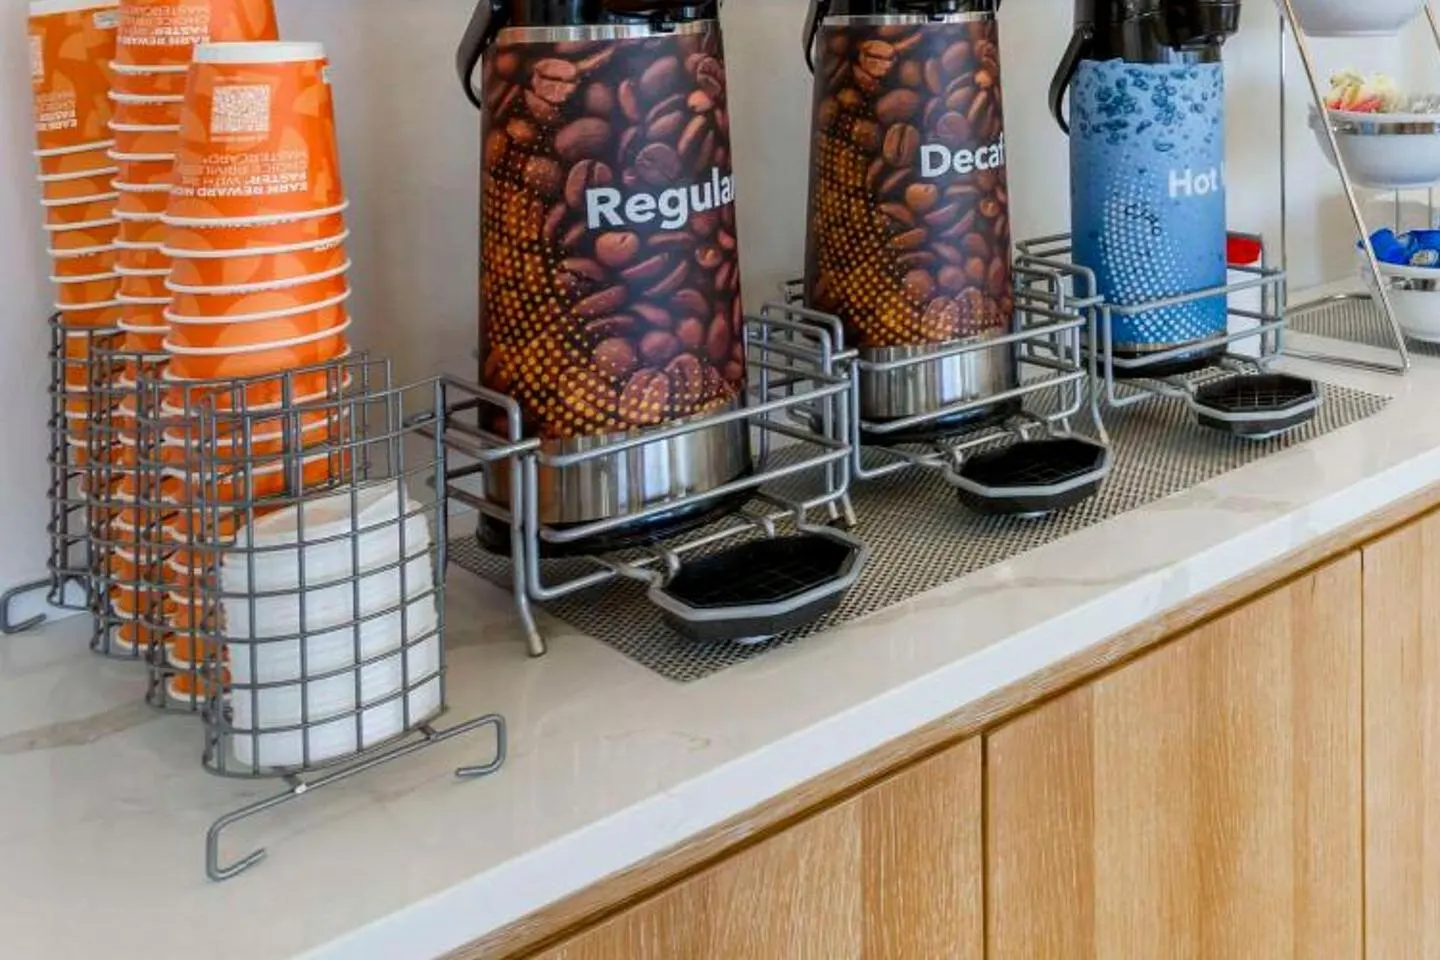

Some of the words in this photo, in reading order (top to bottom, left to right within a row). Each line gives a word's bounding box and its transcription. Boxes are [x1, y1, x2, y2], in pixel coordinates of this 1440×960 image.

[267, 181, 309, 196] EARN
[1169, 167, 1218, 197] Hot
[197, 184, 264, 197] REWARD
